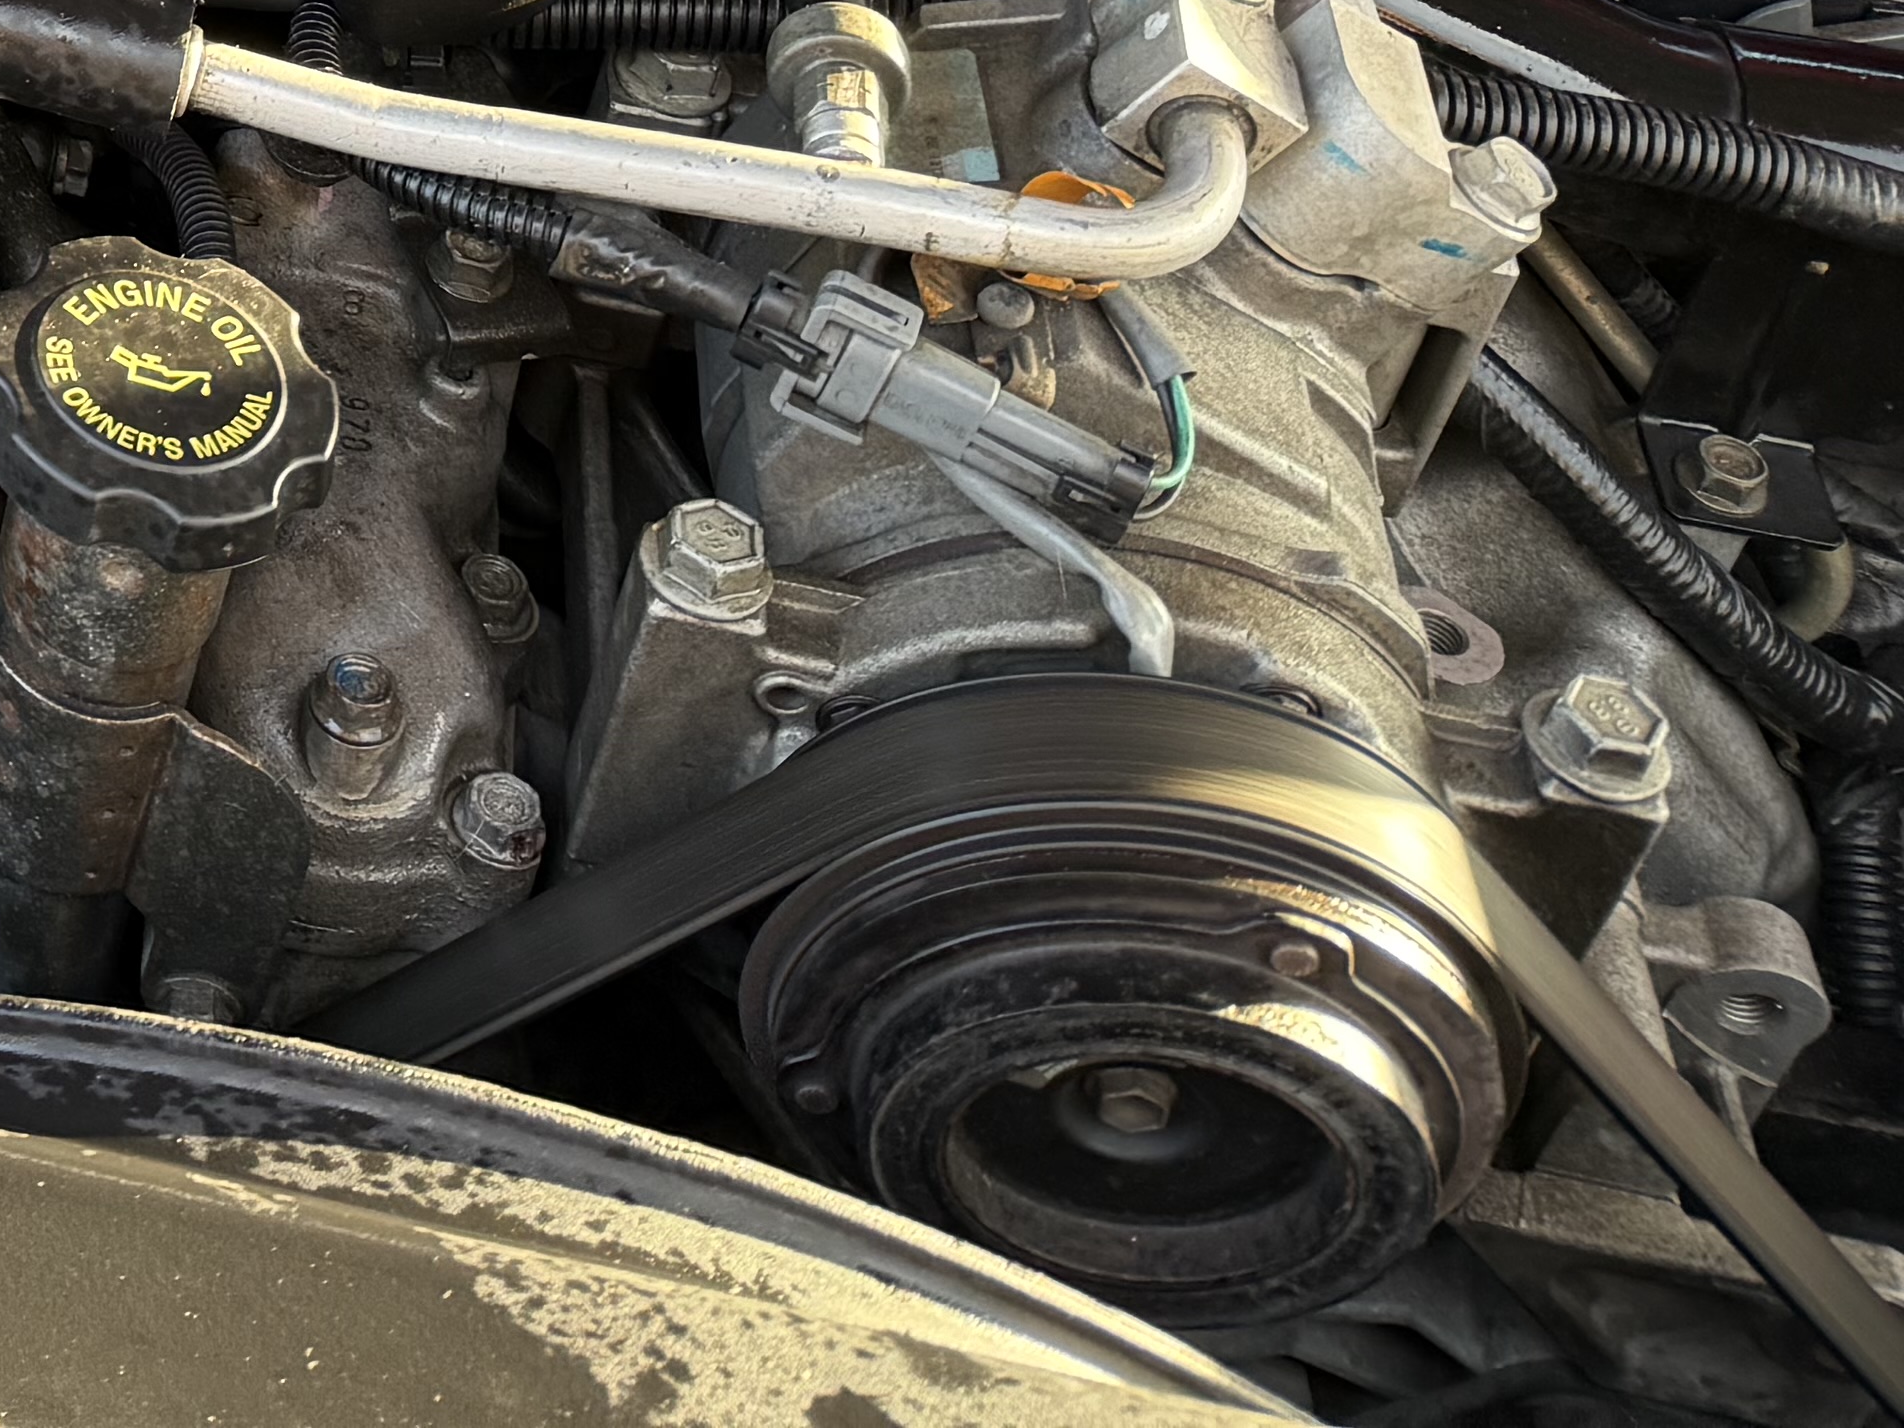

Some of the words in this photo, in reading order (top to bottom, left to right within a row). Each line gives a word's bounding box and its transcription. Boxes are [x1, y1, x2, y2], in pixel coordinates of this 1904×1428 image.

[44, 334, 81, 386] SEE
[62, 278, 212, 327] ENGINE
[209, 314, 263, 368] OIL
[62, 385, 185, 462] OWNER'S
[188, 388, 274, 461] MANUAL
